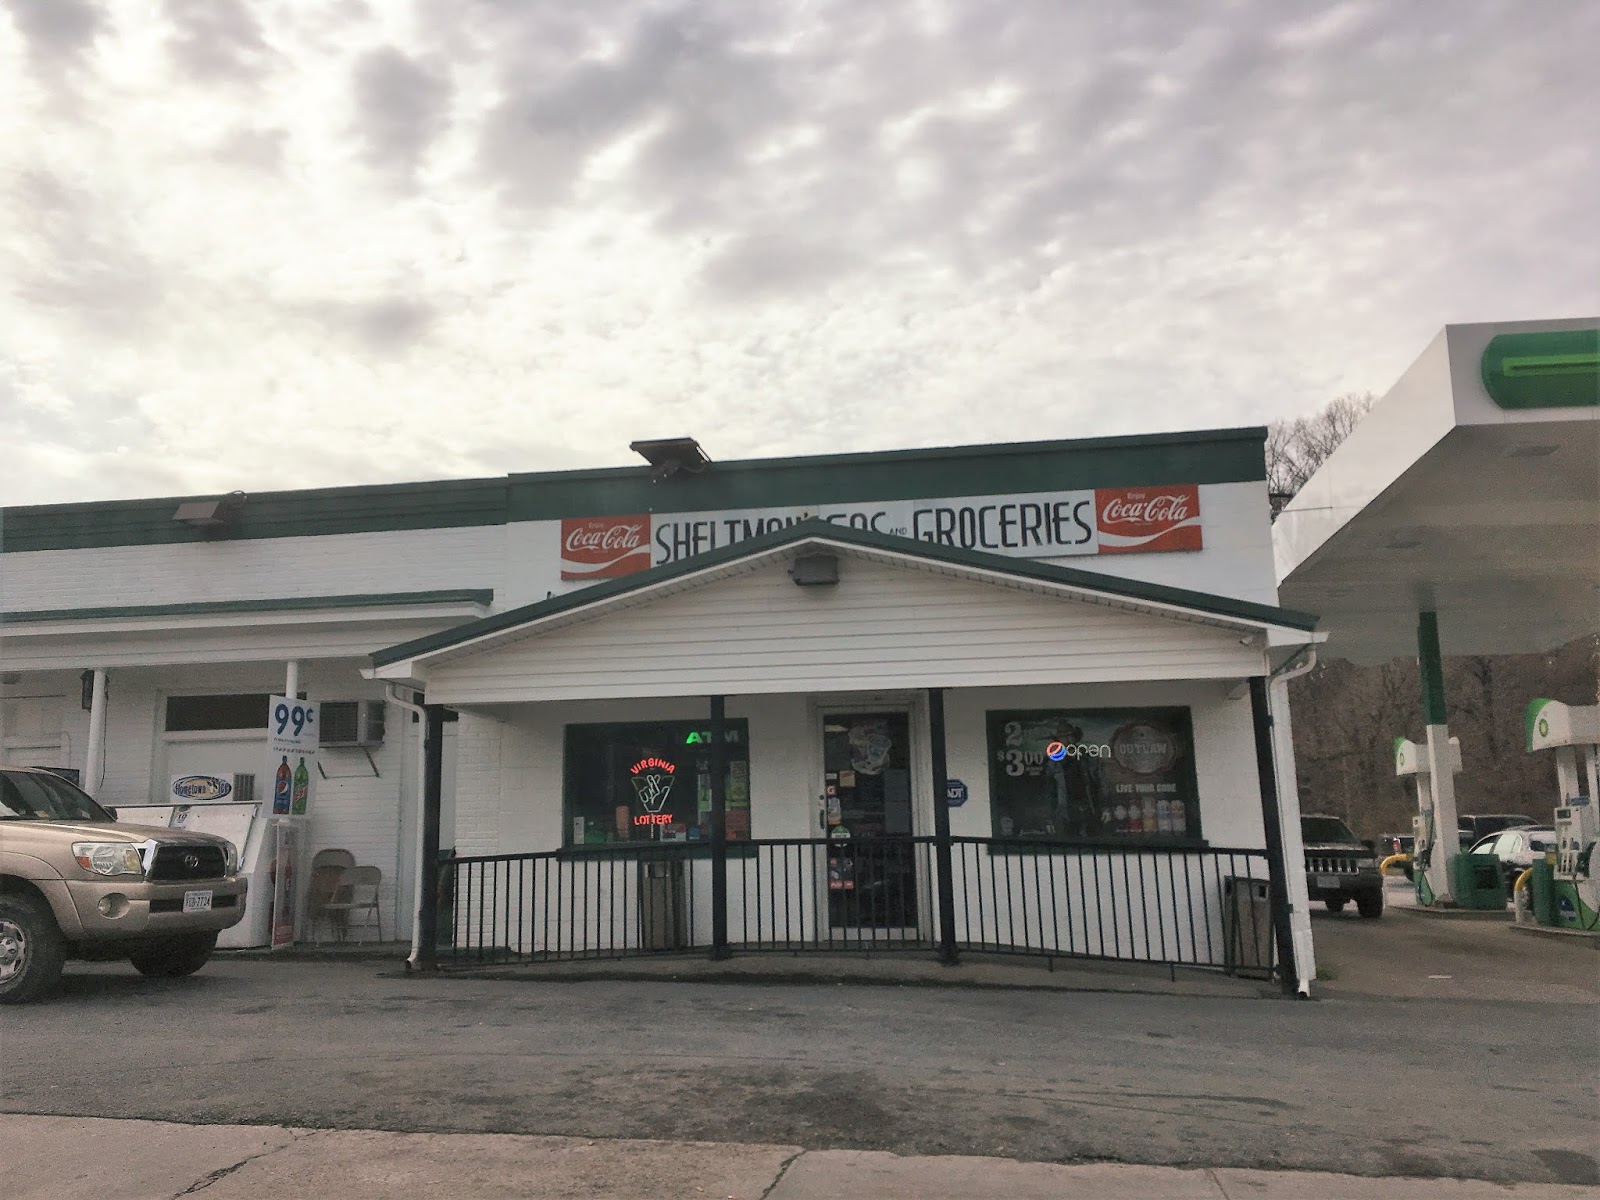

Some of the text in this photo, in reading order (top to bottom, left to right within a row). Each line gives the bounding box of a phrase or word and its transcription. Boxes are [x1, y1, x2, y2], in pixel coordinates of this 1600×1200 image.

[1103, 494, 1190, 525] Coca-Cola
[913, 500, 1092, 550] GROCERIES
[565, 524, 643, 552] Coca-Cola
[1066, 744, 1112, 761] open
[630, 757, 676, 774] VIRGINIA
[633, 813, 673, 826] LOTTERY
